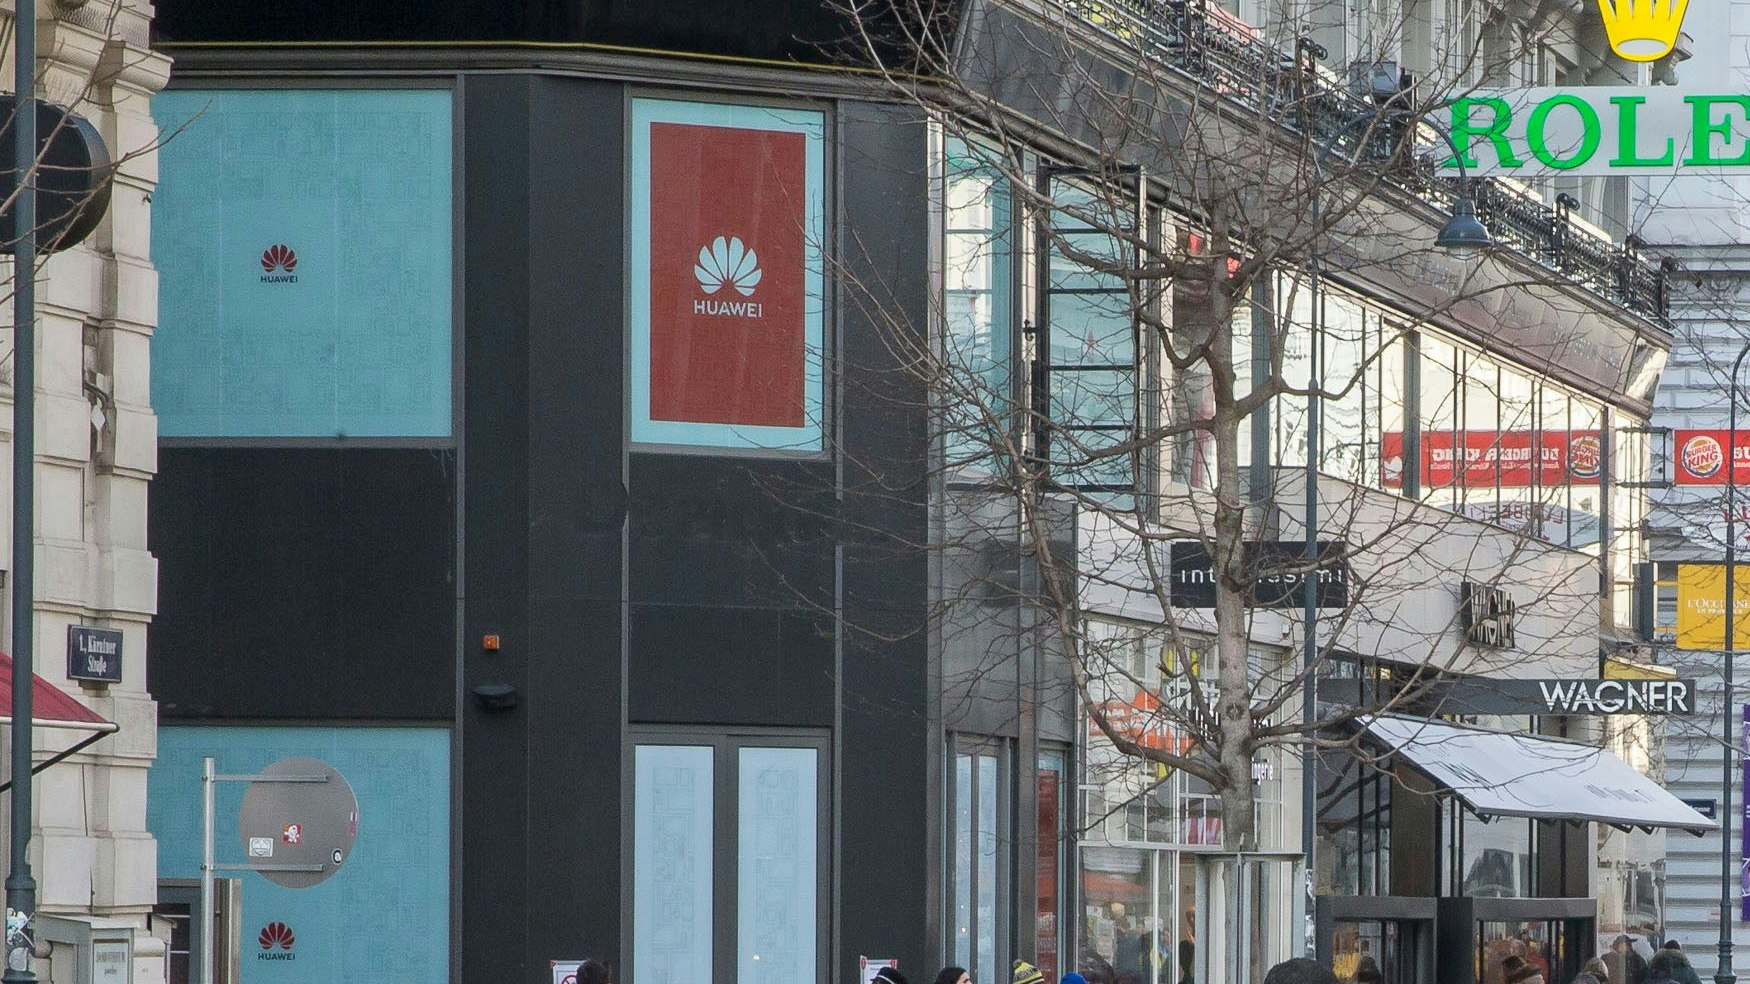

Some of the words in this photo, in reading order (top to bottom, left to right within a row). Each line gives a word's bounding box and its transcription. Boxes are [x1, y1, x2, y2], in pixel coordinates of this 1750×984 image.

[261, 275, 298, 284] HUAWEI
[694, 300, 762, 318] HUAWEI
[1539, 681, 1689, 713] WAGNER
[257, 952, 296, 961] HUAWEI
